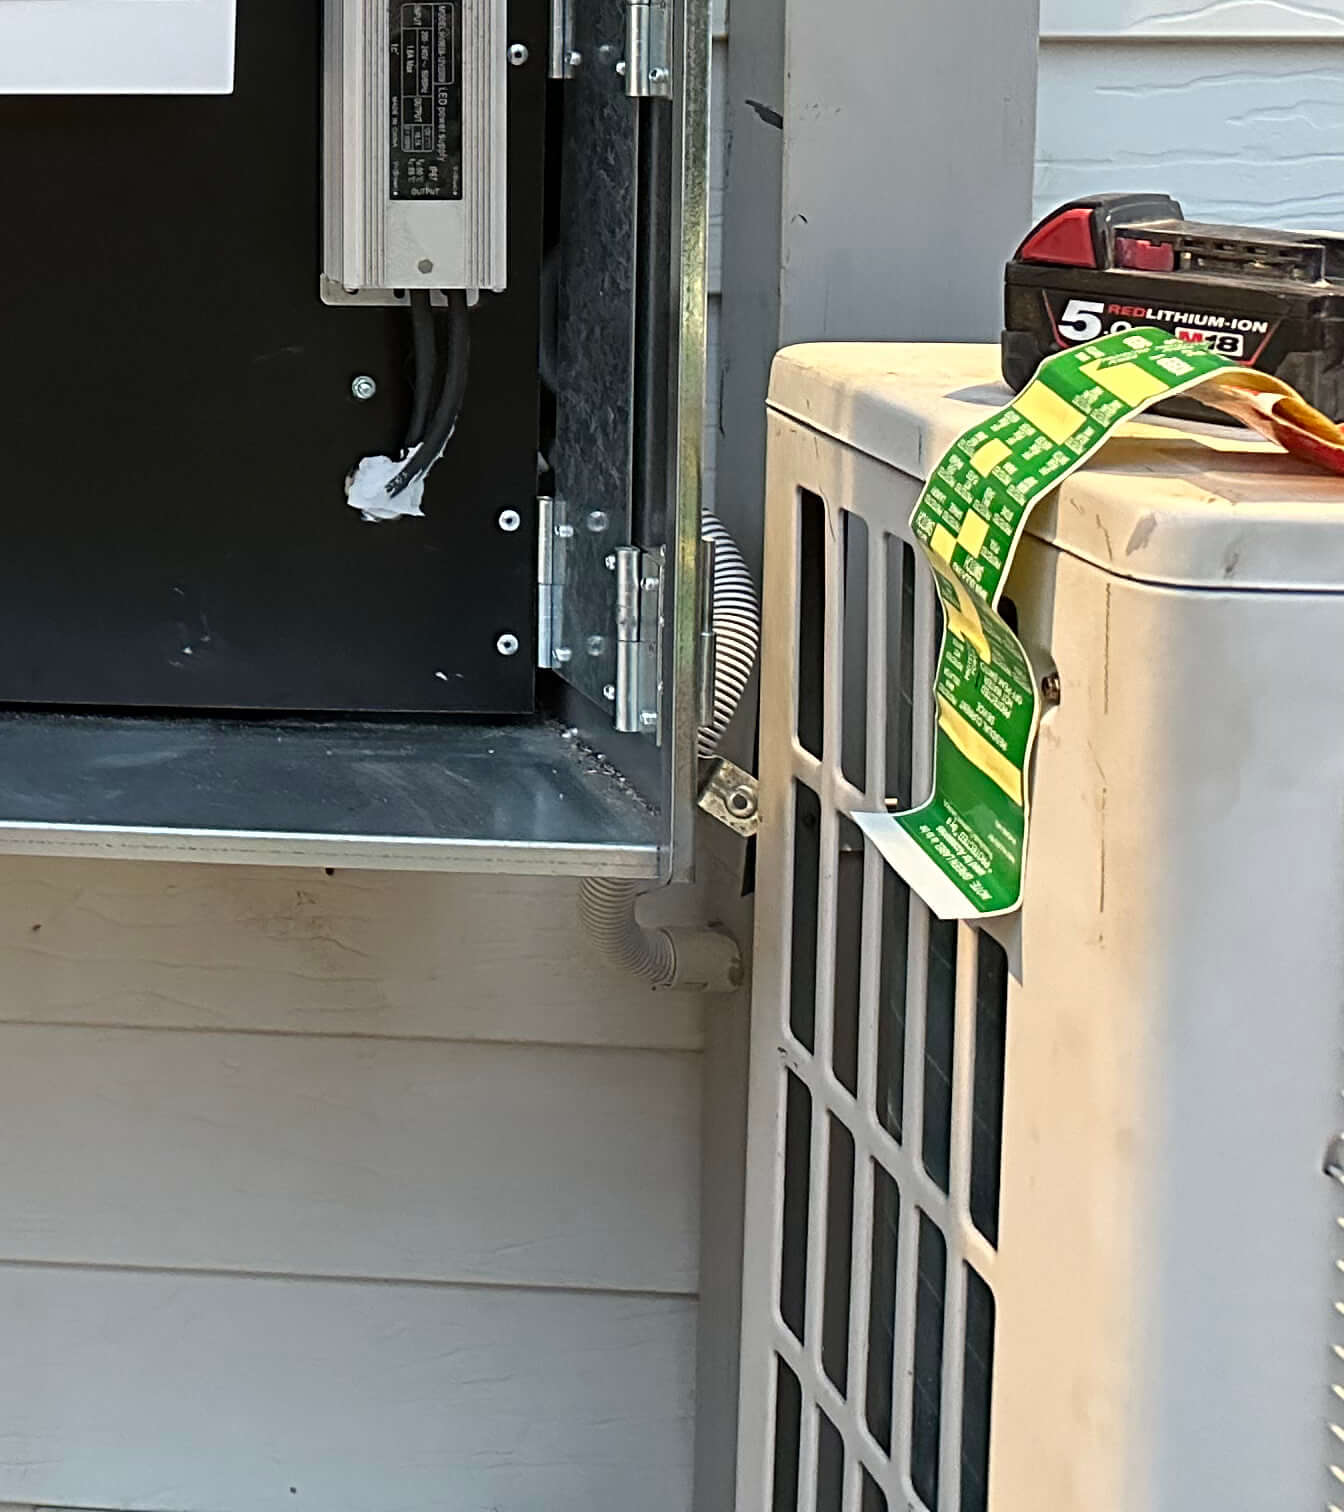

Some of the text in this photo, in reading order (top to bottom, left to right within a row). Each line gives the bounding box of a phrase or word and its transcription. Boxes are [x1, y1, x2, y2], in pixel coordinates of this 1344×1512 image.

[438, 87, 448, 105] LED
[414, 98, 422, 122] OUTPUT
[437, 107, 446, 132] power
[436, 134, 448, 161] supply
[1107, 304, 1268, 333] REDLITHIUM-ION
